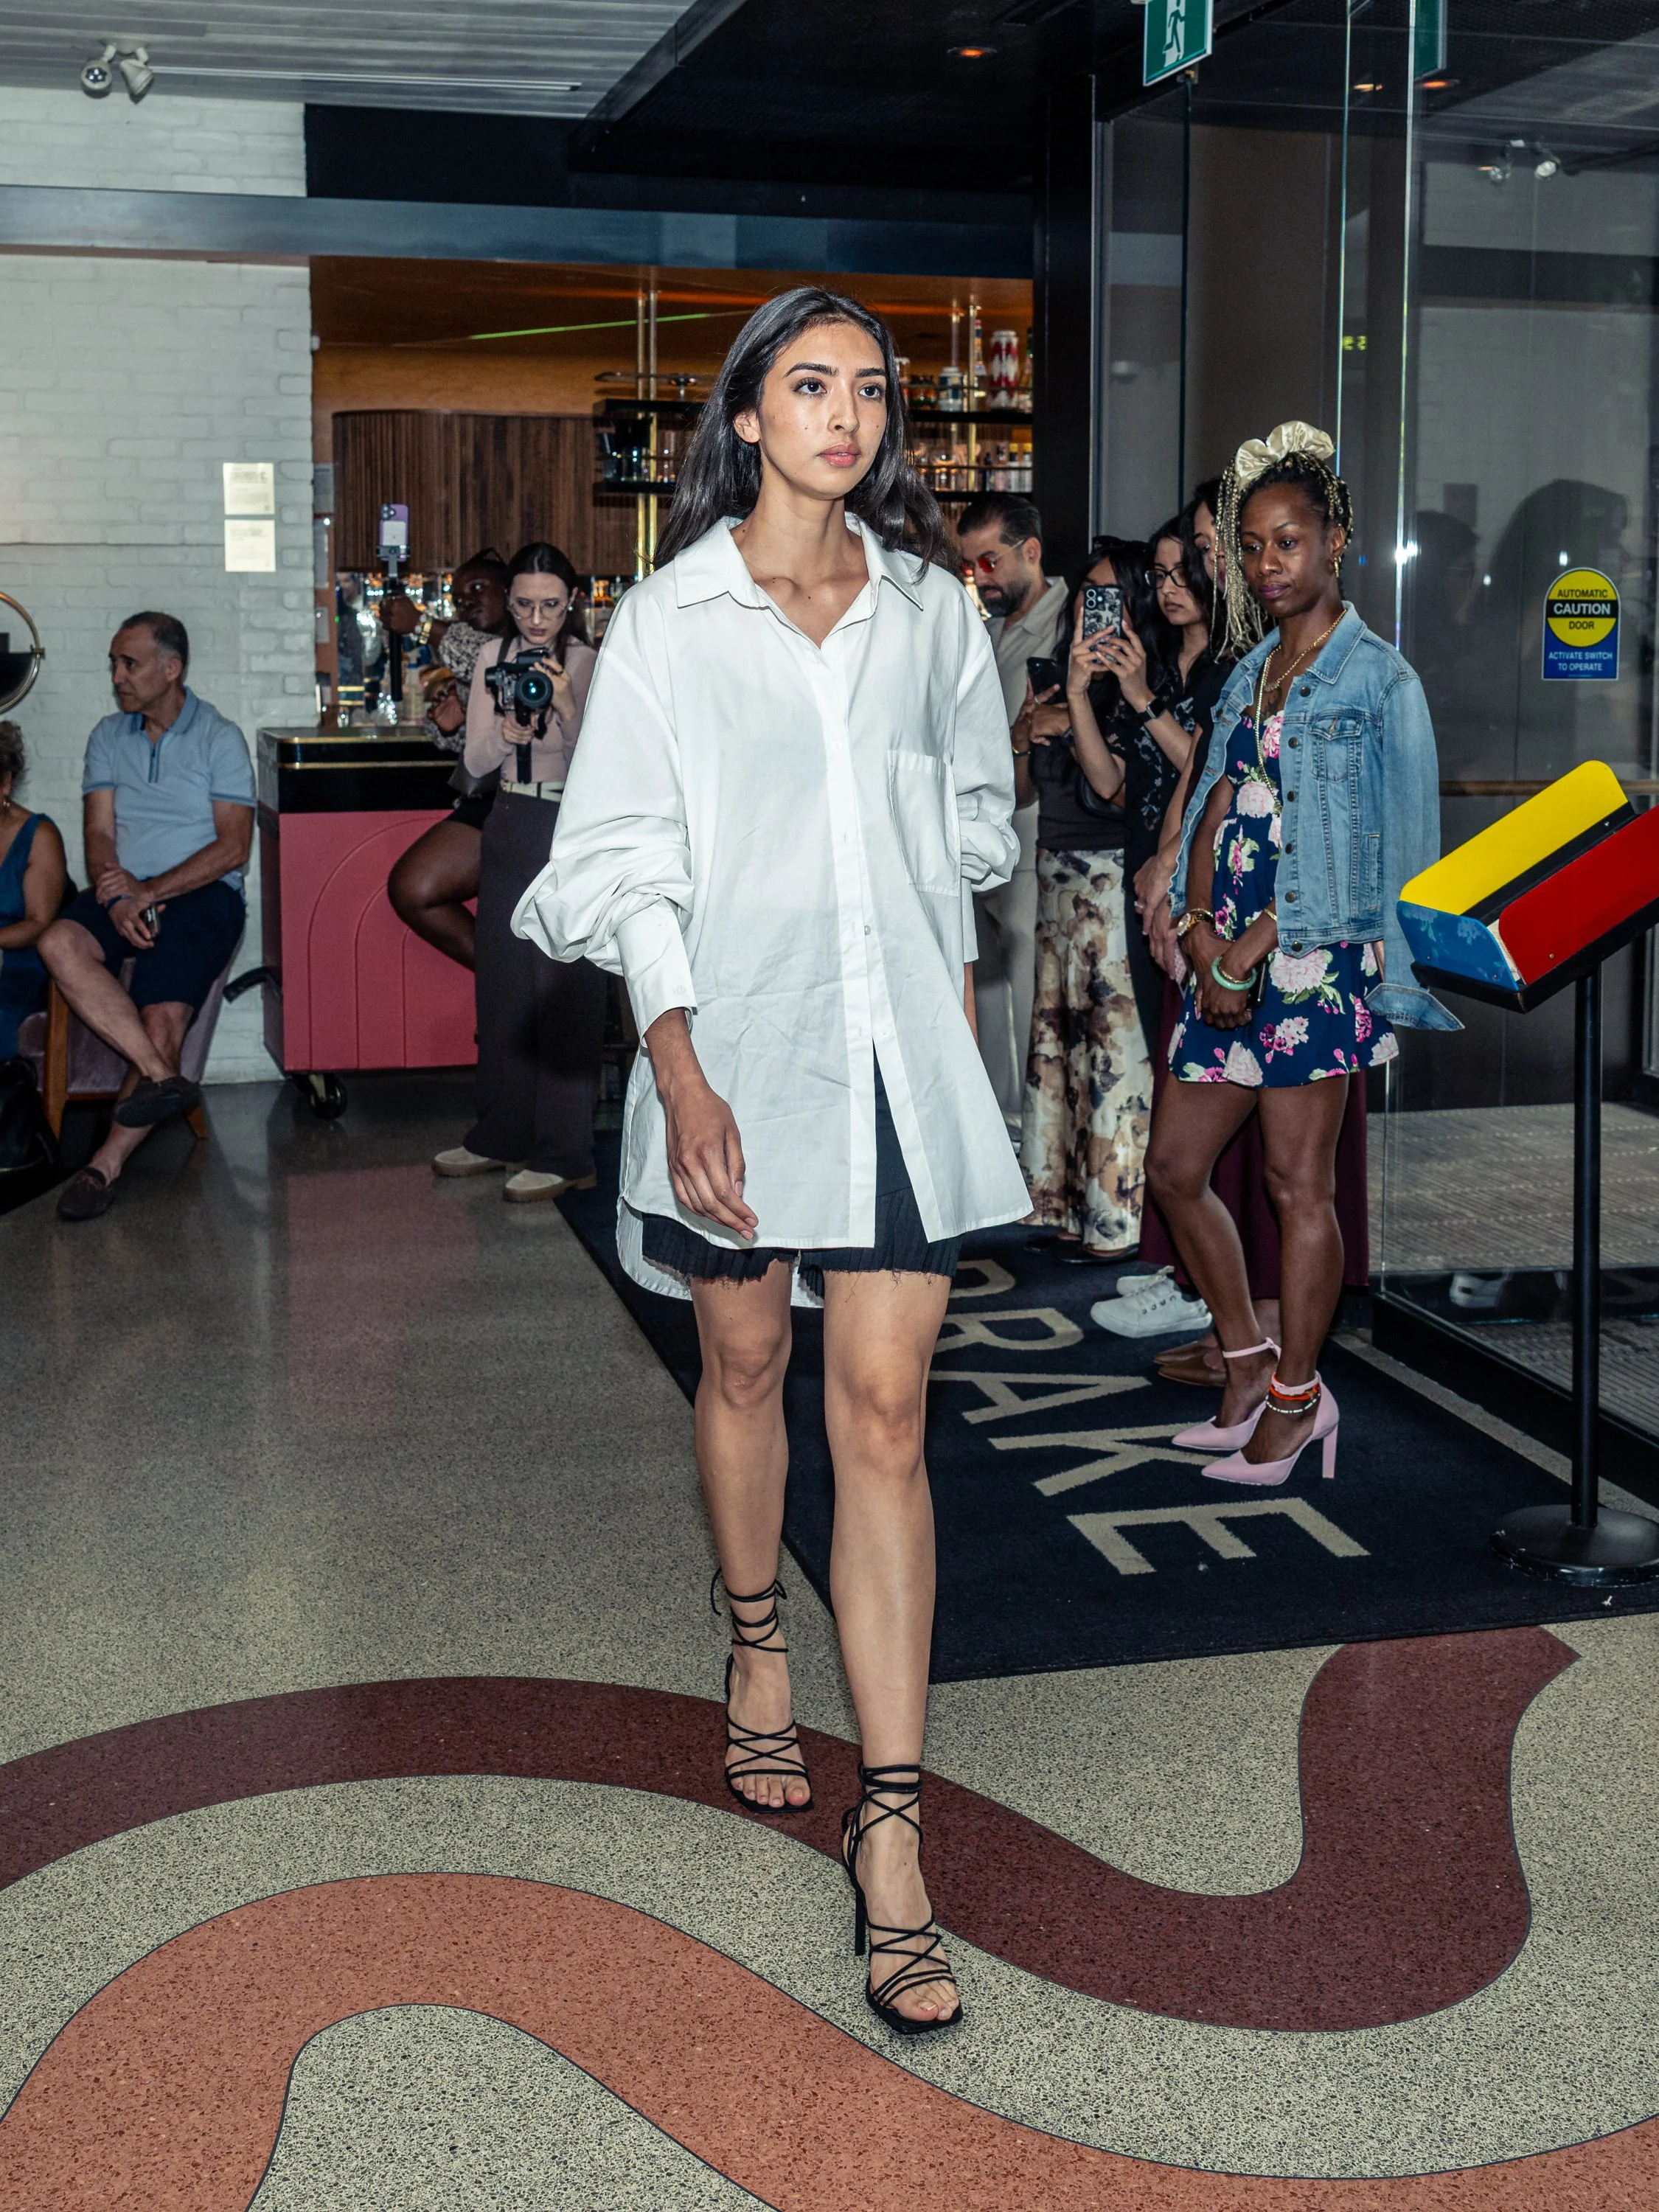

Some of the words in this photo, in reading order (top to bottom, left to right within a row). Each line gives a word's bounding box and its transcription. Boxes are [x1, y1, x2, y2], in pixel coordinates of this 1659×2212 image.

[1557, 589, 1607, 597] AUTOMATIC
[1554, 602, 1610, 614] CAUTION
[1568, 621, 1594, 629] DOOR
[1548, 651, 1582, 659] ACTIVATE
[1585, 651, 1613, 659] SWITCH
[1558, 662, 1567, 670] TO
[1569, 662, 1602, 670] OPERATE
